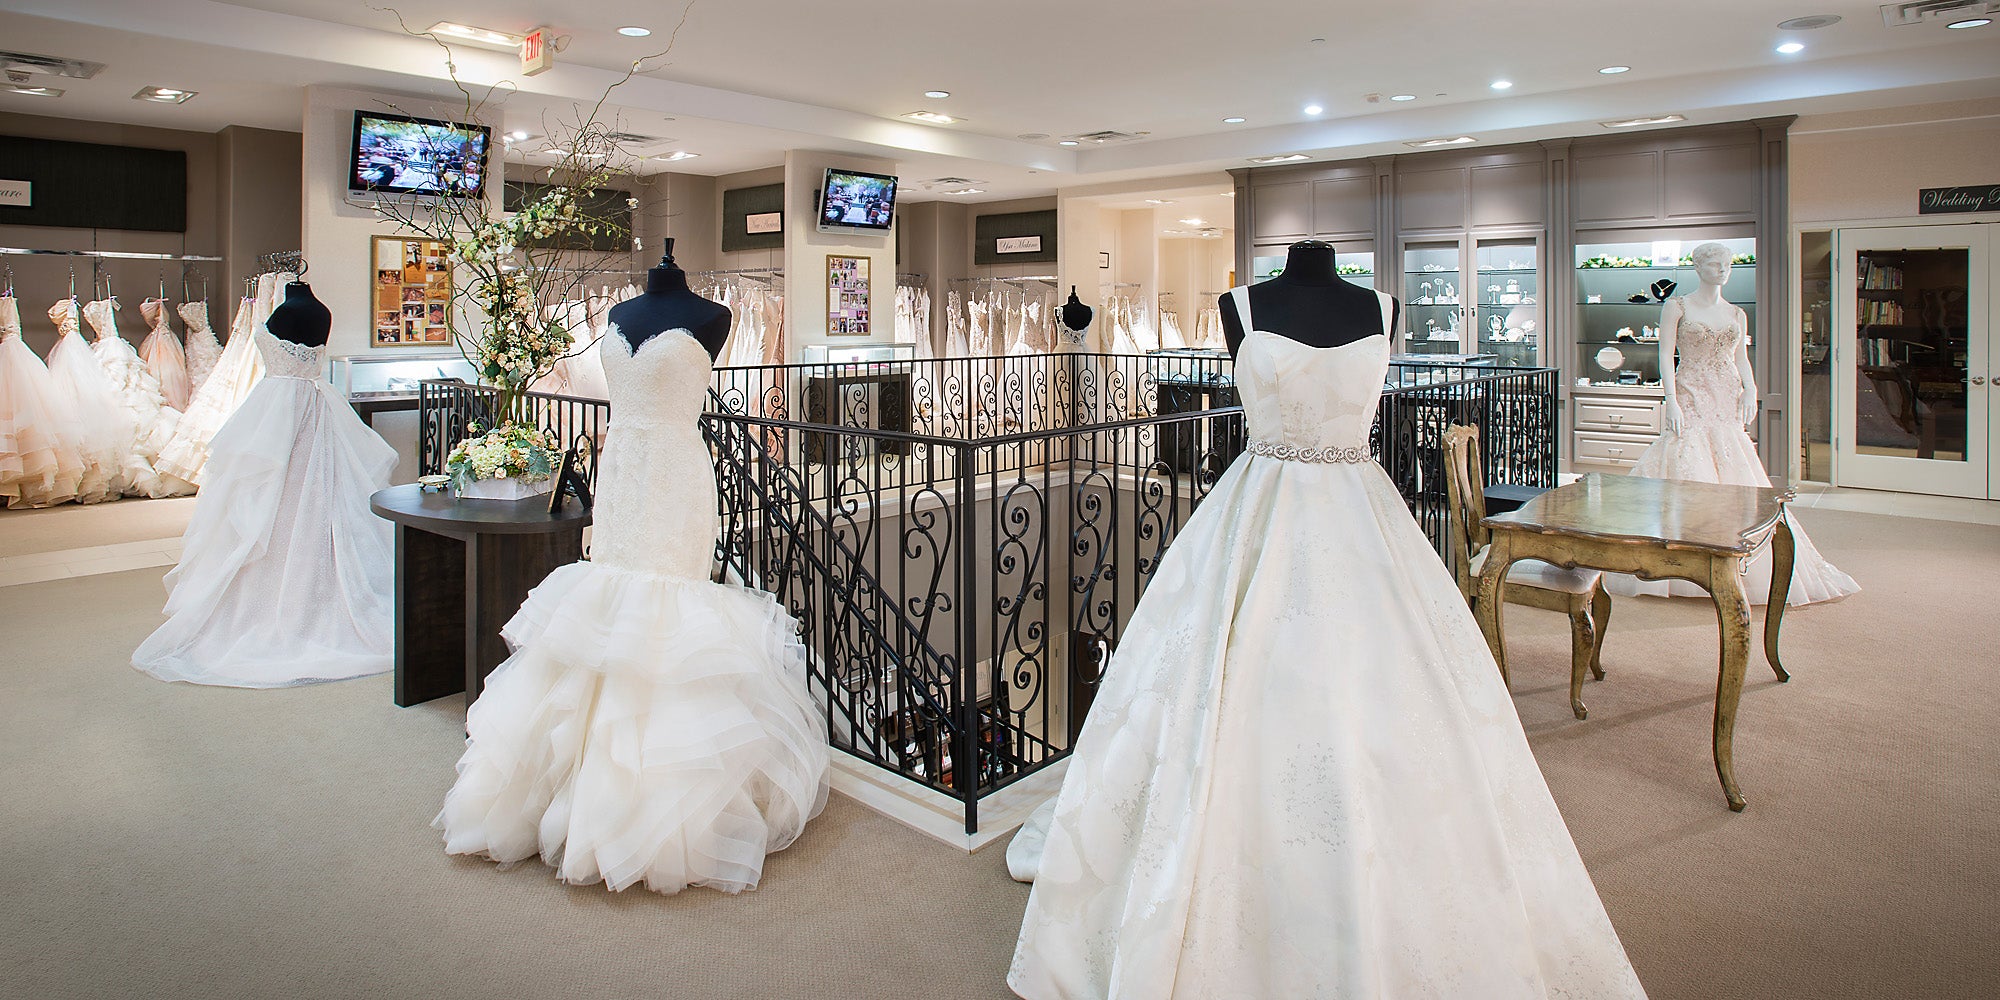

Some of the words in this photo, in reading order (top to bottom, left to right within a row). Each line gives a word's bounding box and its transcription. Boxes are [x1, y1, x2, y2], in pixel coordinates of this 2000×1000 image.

[526, 32, 541, 62] EXIT
[0, 190, 22, 198] aro
[1923, 187, 1984, 212] Wedding
